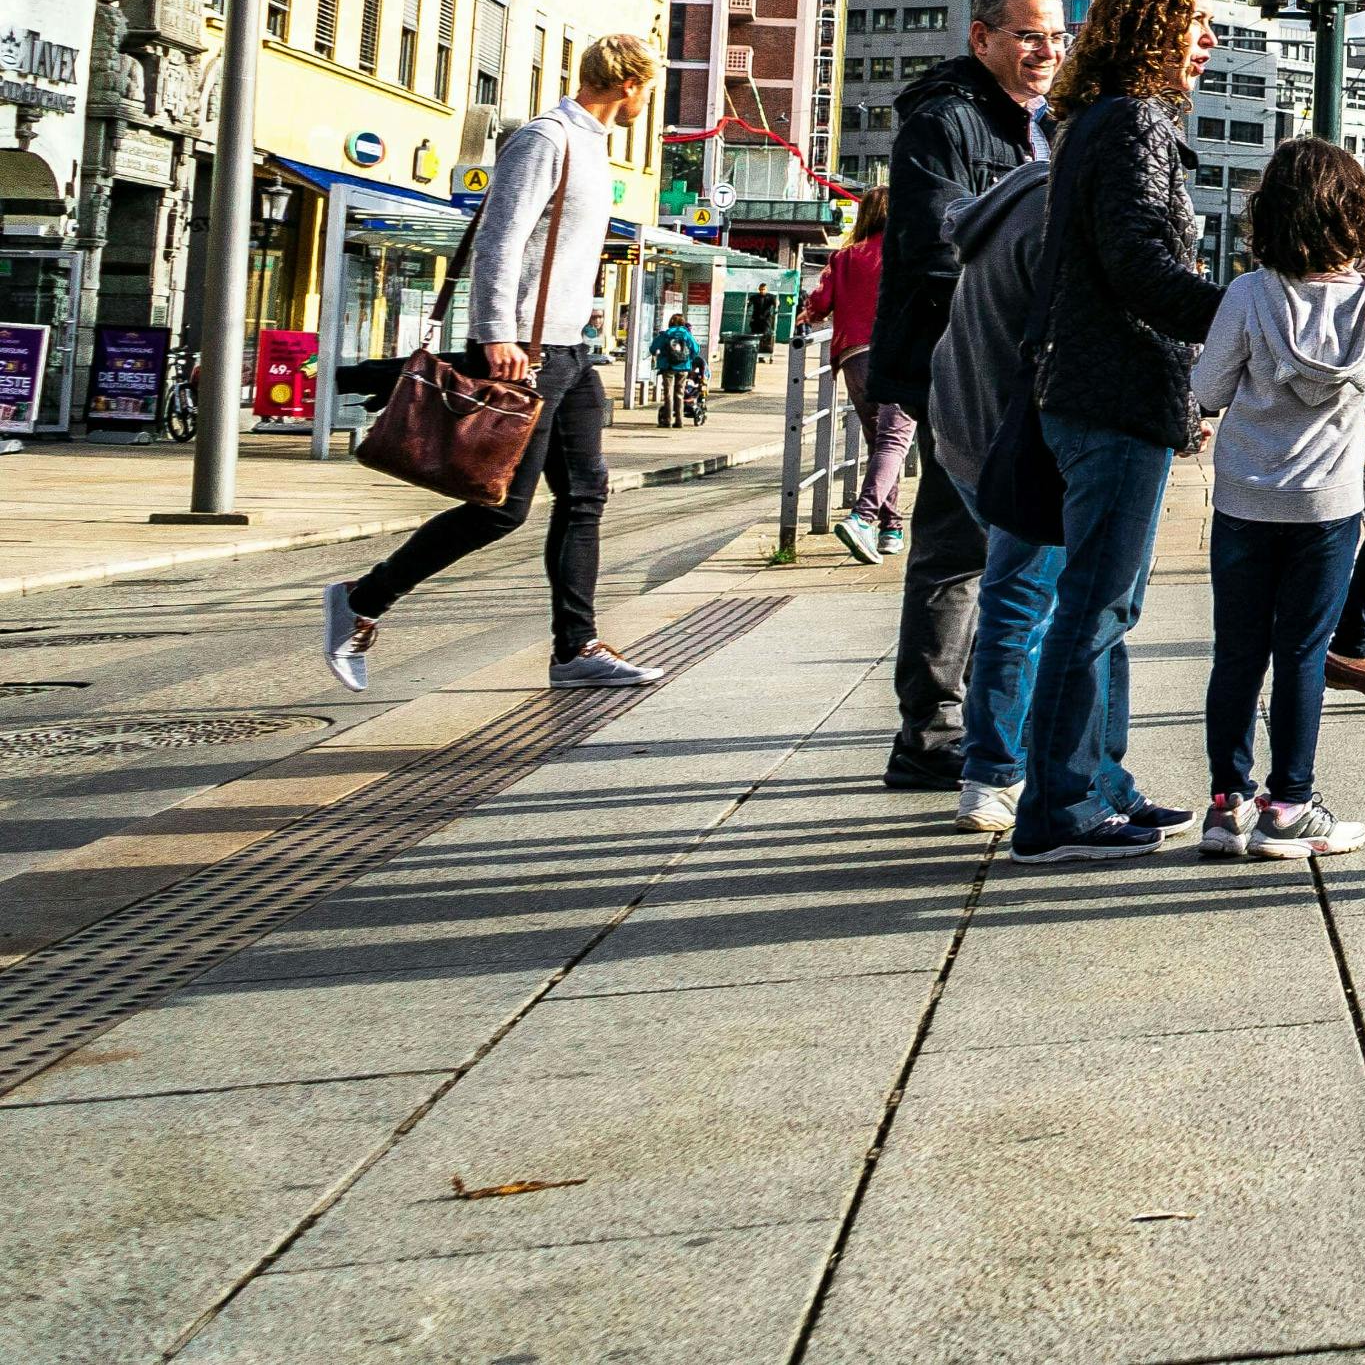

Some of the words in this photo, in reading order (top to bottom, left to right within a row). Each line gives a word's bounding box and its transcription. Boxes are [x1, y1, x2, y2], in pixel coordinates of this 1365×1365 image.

[468, 171, 483, 187] A
[696, 210, 707, 222] A
[98, 371, 115, 382] DE
[118, 372, 156, 384] BESTE
